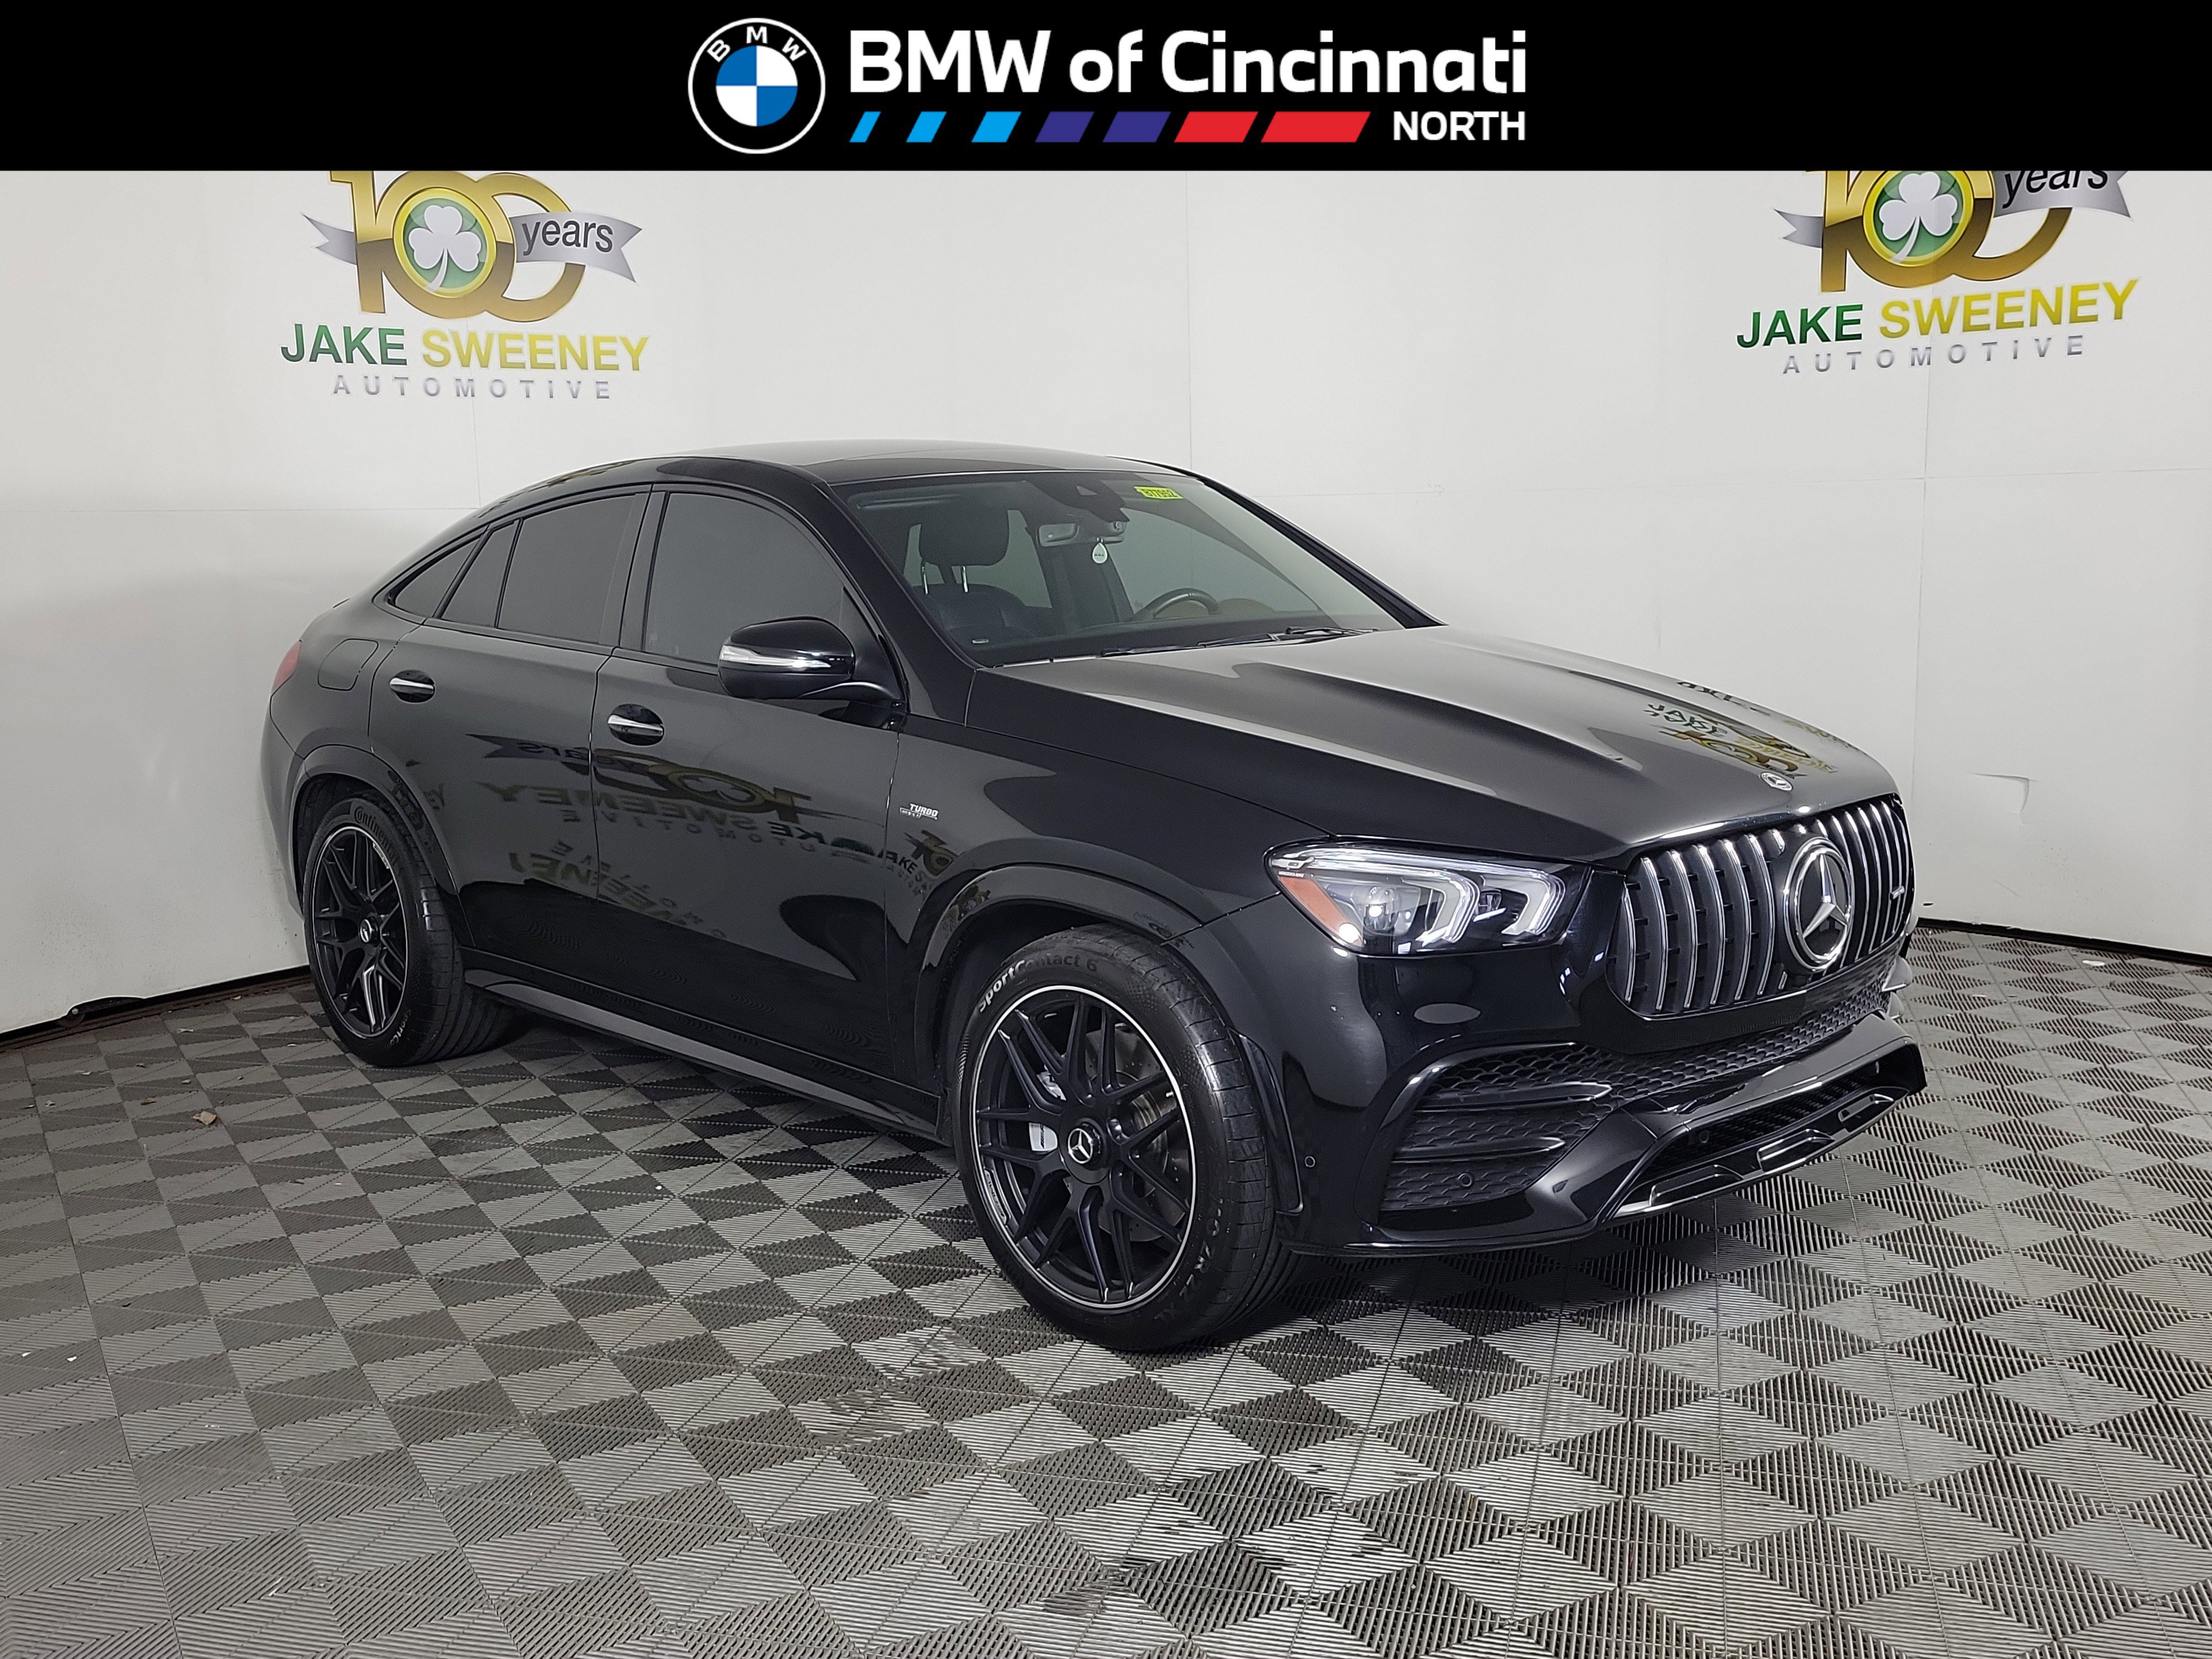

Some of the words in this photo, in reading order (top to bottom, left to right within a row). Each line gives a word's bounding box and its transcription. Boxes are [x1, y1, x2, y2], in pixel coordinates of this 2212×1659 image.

[522, 219, 613, 256] years
[1737, 303, 1864, 348] JAKE
[1879, 279, 2138, 338] SWEENEY
[280, 323, 407, 366] JAKE
[422, 329, 648, 371] SWEENEY
[1782, 335, 2084, 374] AUTOMOTIVE
[334, 375, 610, 399] AUTOMOTIVE
[910, 803, 939, 817] TURBO
